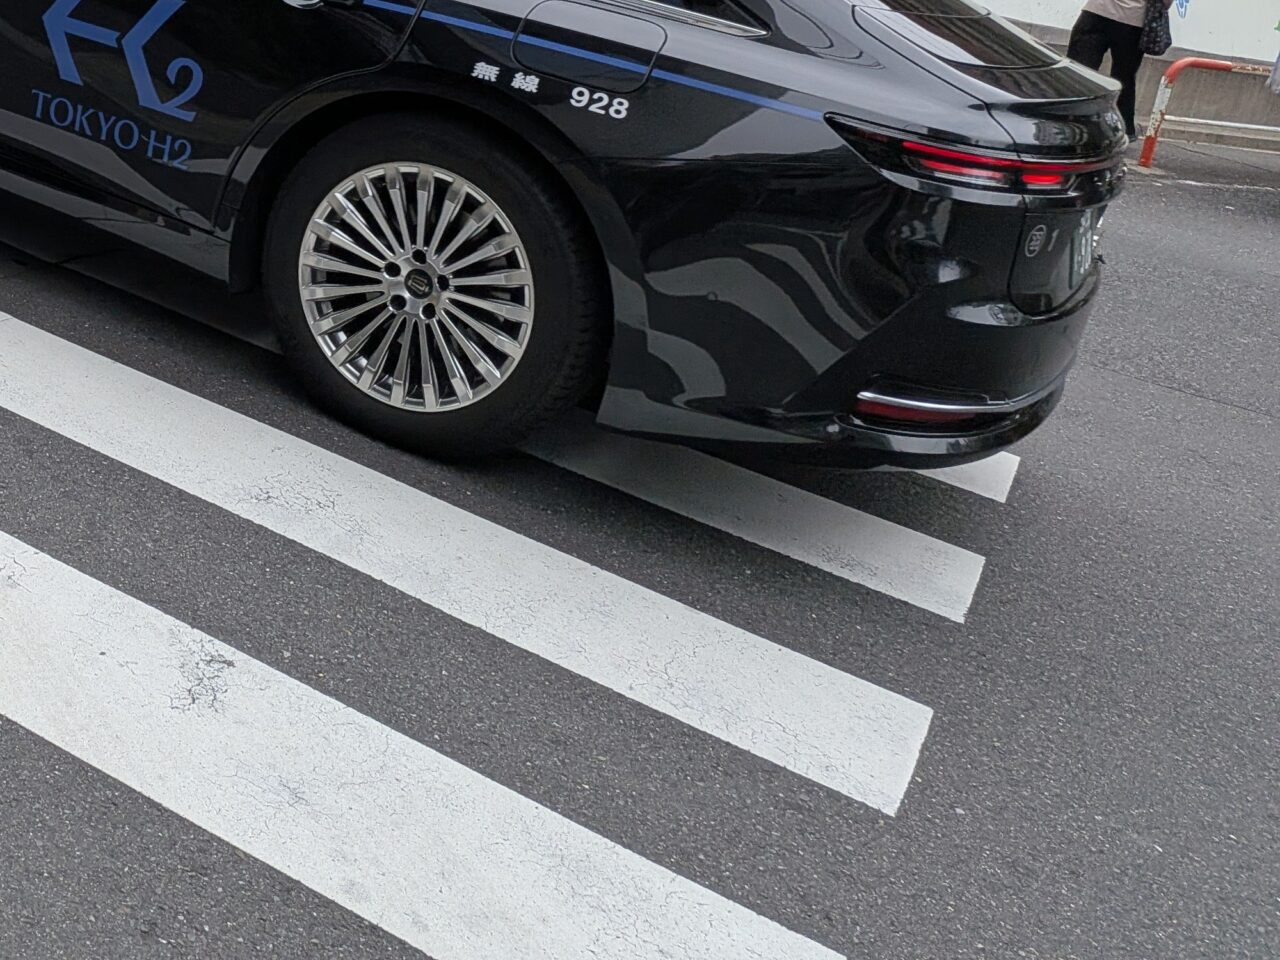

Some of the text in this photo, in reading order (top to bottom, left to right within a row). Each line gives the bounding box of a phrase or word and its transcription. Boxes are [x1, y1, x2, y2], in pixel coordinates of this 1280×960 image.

[32, 89, 192, 170] TOKYO H2
[569, 86, 630, 119] 928
